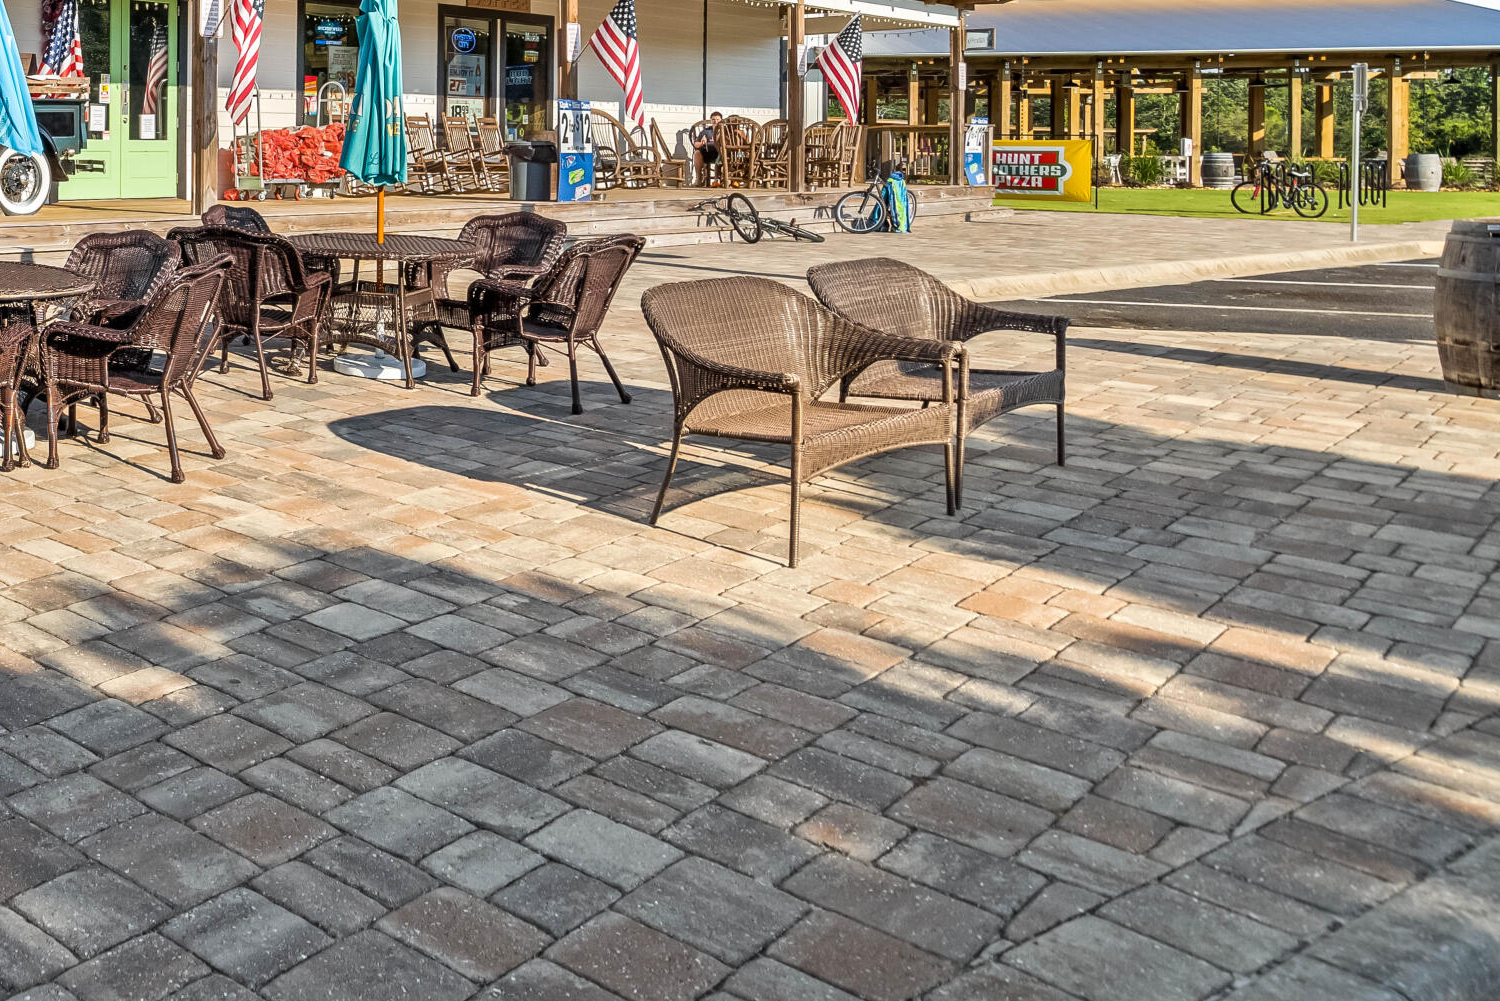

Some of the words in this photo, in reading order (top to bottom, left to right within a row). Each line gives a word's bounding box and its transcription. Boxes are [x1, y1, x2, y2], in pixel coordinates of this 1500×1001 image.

[562, 112, 569, 144] 2
[996, 153, 1042, 164] HUNT
[993, 165, 1061, 175] OTHERS
[995, 176, 1042, 187] PIZZA
